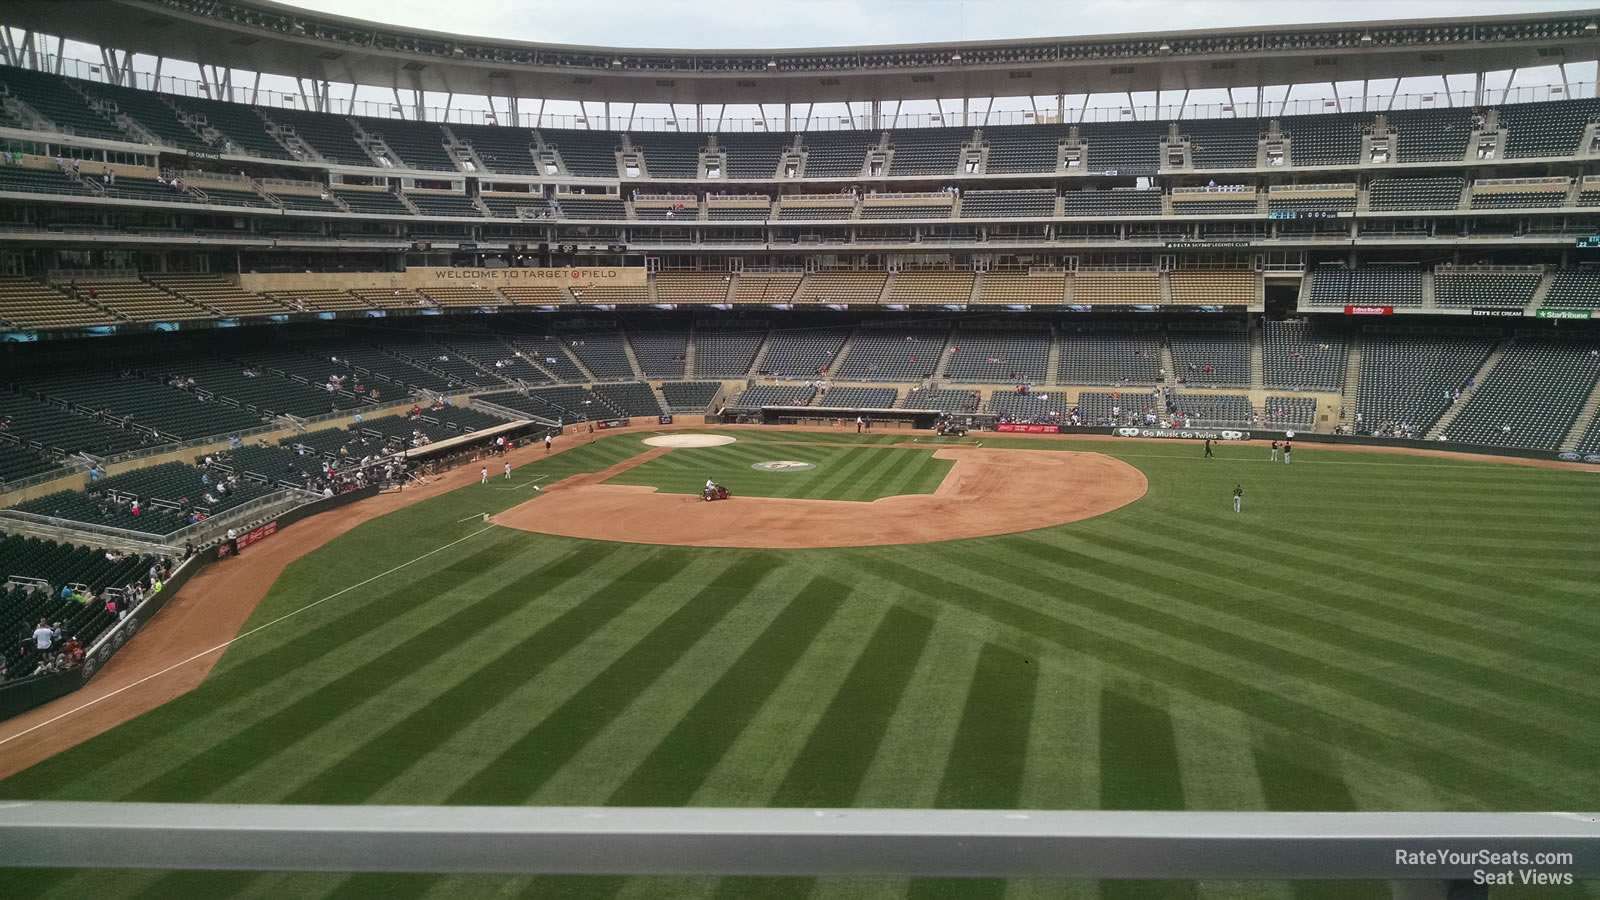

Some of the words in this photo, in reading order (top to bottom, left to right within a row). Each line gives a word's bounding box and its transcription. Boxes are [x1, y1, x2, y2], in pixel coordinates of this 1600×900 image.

[435, 270, 499, 279] WELCOME
[502, 270, 519, 279] TO
[521, 270, 569, 279] TARGET
[581, 270, 617, 278] FIELD
[1547, 311, 1588, 319] StarTribune
[1156, 430, 1179, 438] Music
[1181, 431, 1193, 439] Go
